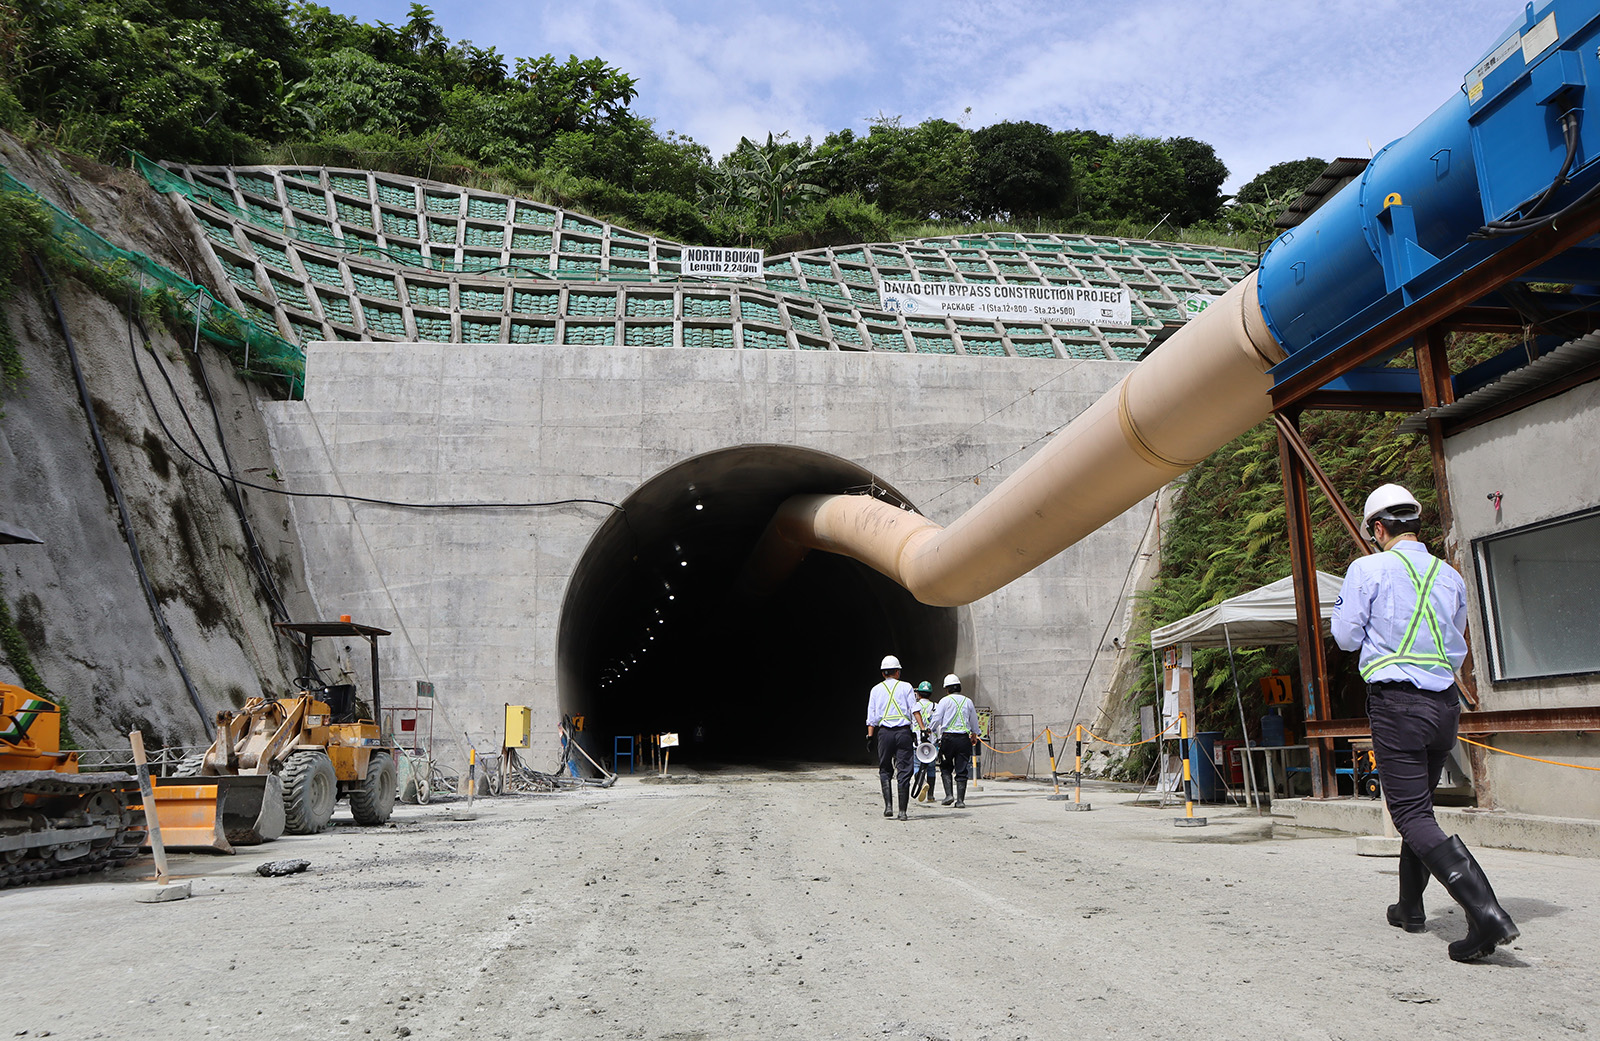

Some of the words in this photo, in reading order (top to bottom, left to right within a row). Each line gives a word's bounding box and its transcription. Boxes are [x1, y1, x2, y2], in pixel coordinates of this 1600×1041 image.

[688, 249, 722, 262] NORTH
[725, 250, 760, 263] BOUND
[690, 263, 721, 272] Length
[723, 263, 757, 273] 2,240m
[884, 281, 921, 295] DAVAO
[924, 284, 946, 296] CITY
[948, 285, 991, 298] BYPASS
[994, 286, 1074, 301] CONSTRUCTION
[1076, 290, 1122, 303] PROJECT
[941, 302, 975, 312] PACKAGE
